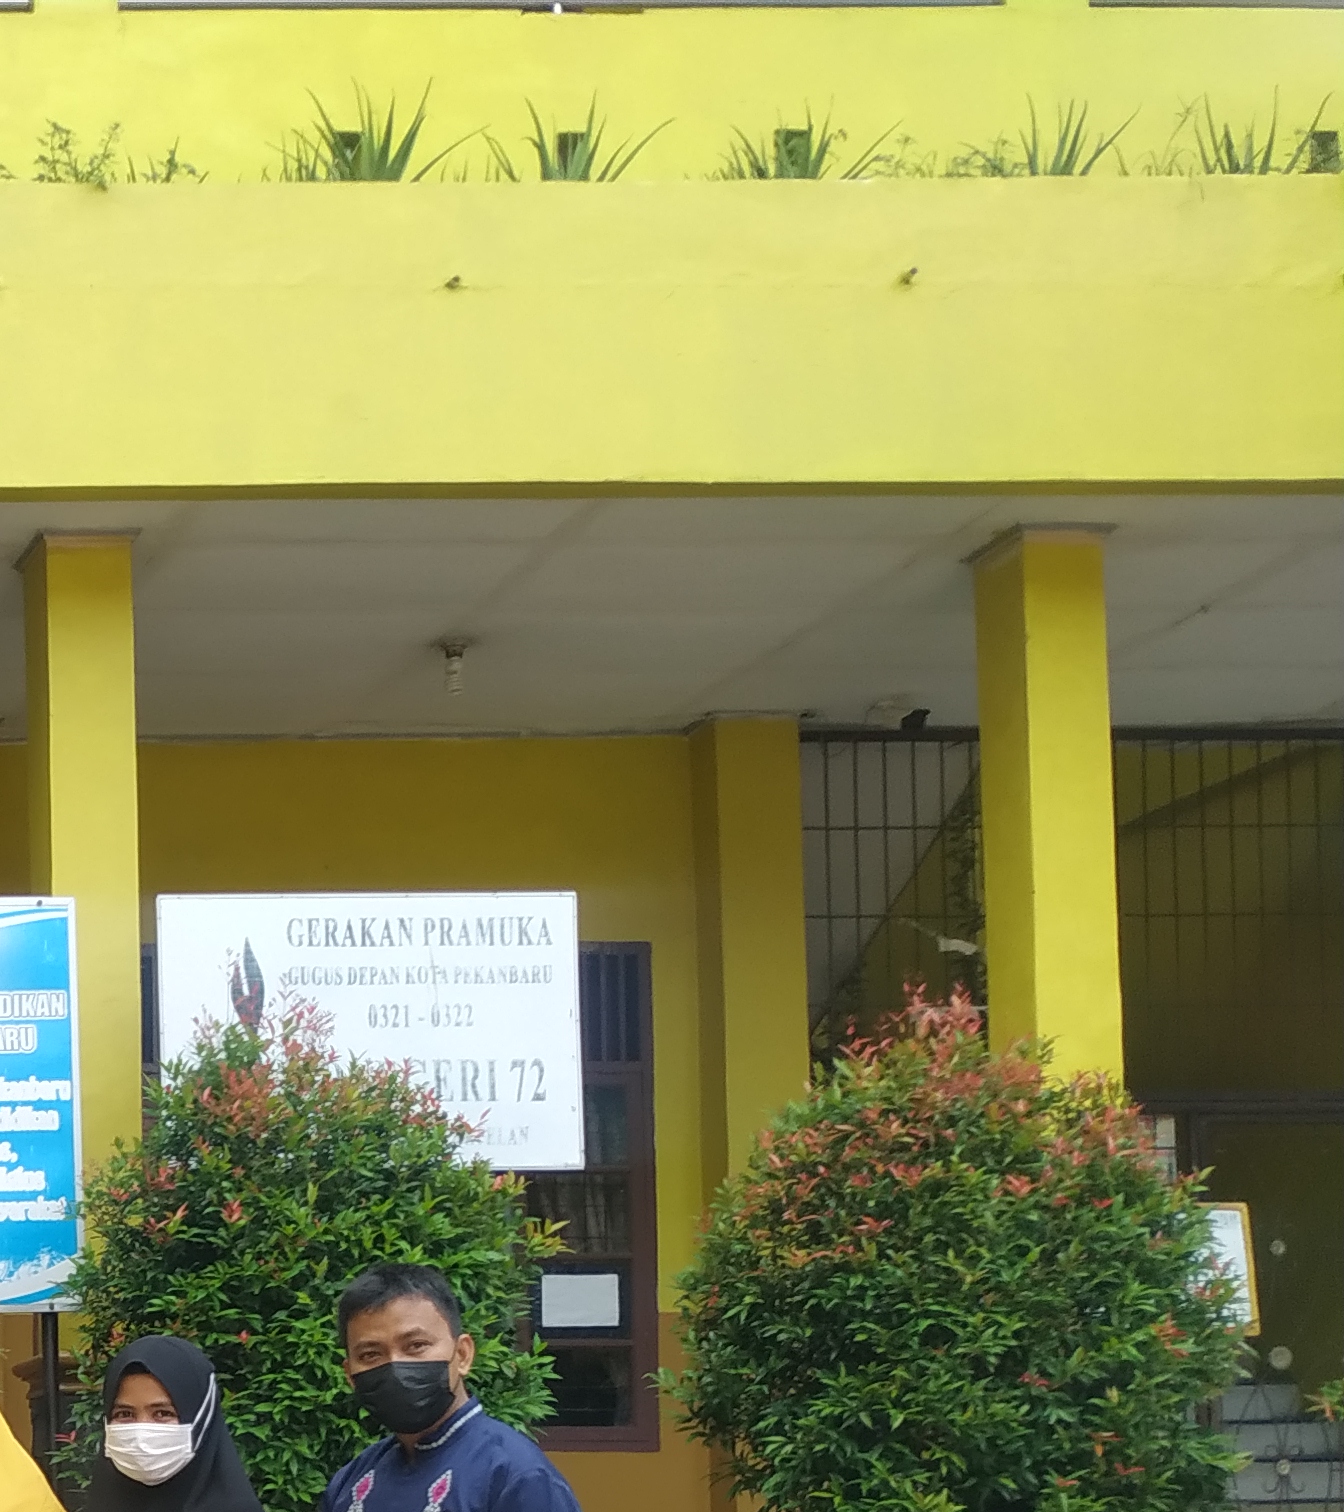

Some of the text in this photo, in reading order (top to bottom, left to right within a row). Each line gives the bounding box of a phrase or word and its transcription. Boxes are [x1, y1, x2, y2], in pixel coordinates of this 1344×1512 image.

[286, 915, 554, 948] GERAKAN PRAMUKA
[288, 964, 553, 986] GUGUS DEPAN KOTA PEKANBARU
[368, 1003, 410, 1029] 0321
[430, 1002, 475, 1028] 0322
[509, 1057, 548, 1103] 72
